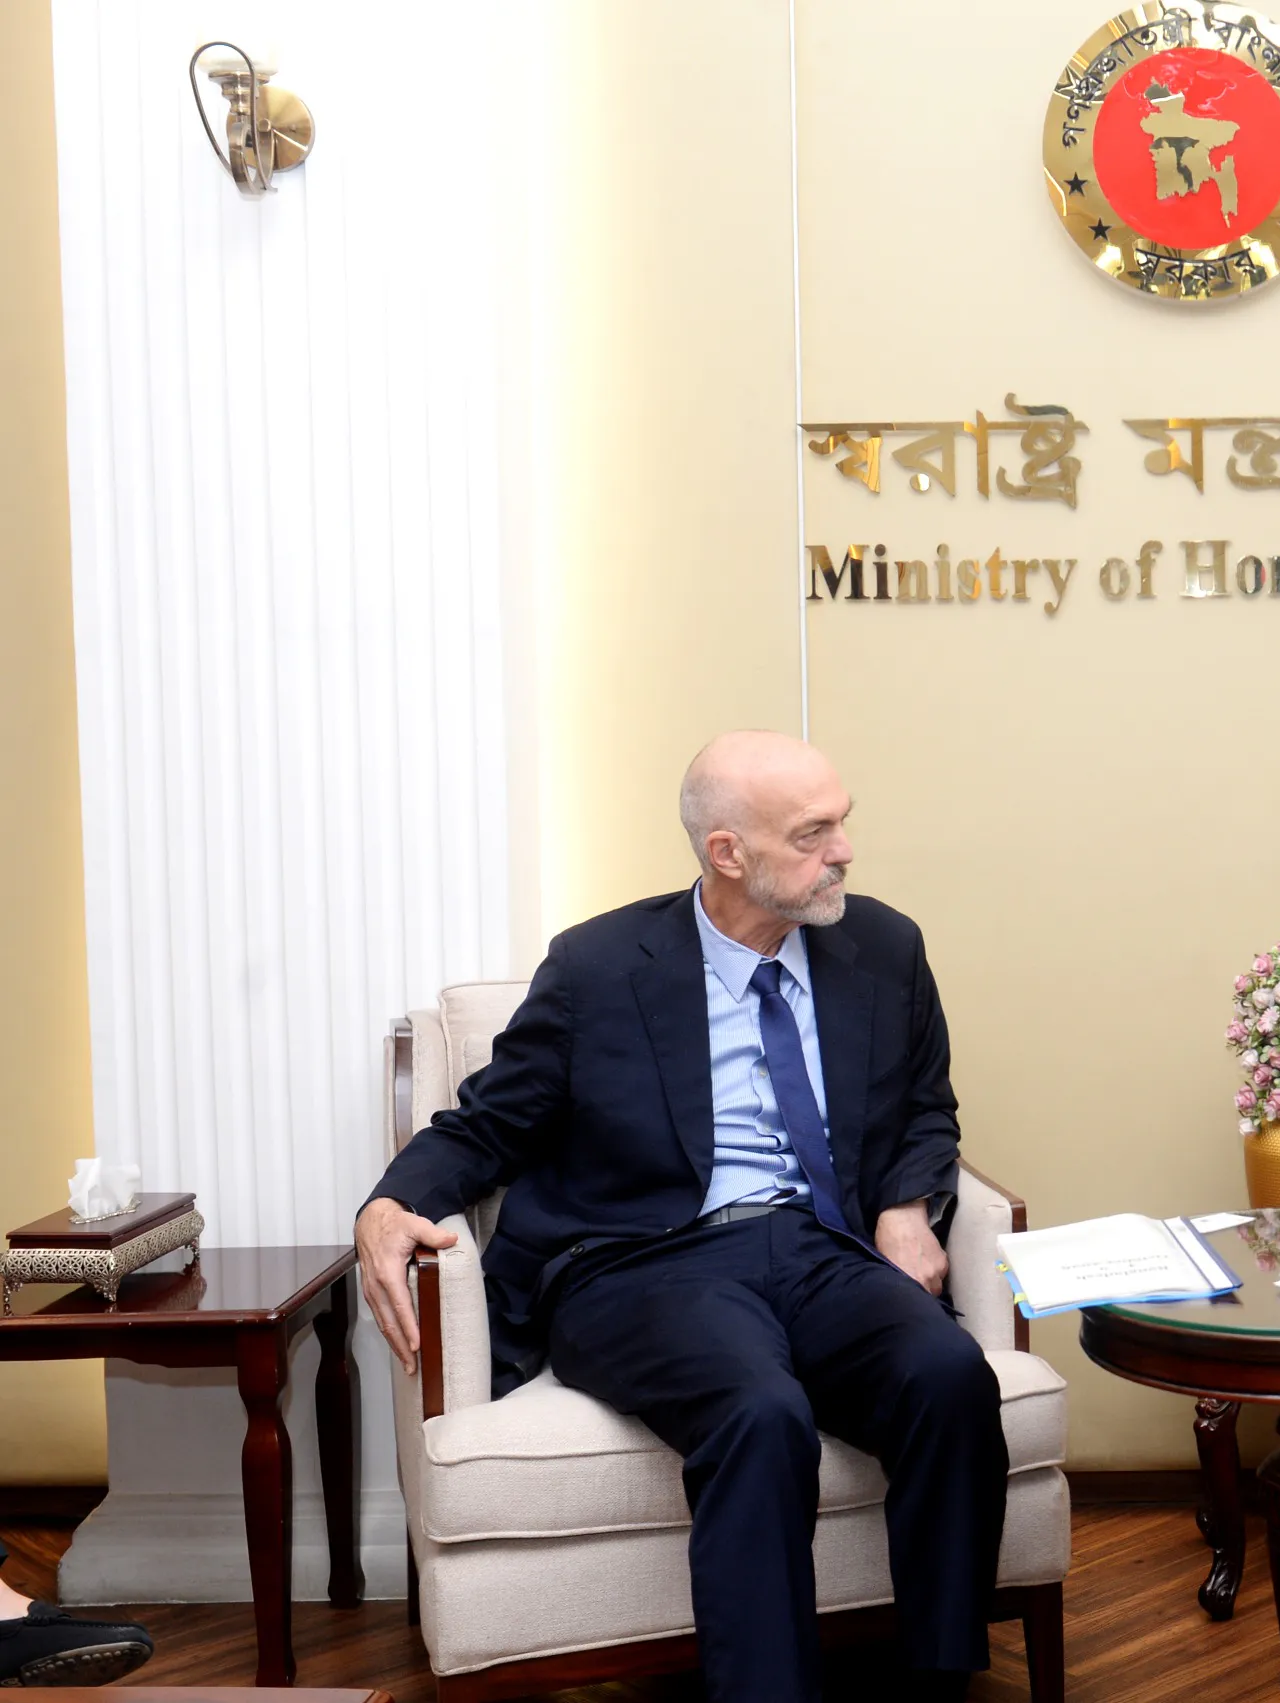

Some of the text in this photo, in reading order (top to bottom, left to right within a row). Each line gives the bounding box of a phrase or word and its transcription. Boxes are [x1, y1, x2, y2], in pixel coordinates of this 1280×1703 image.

[1135, 247, 1252, 284] সরকার
[797, 393, 1090, 510] স্বরাষ্ট্র
[805, 543, 1078, 616] Ministry
[1100, 540, 1163, 599] of
